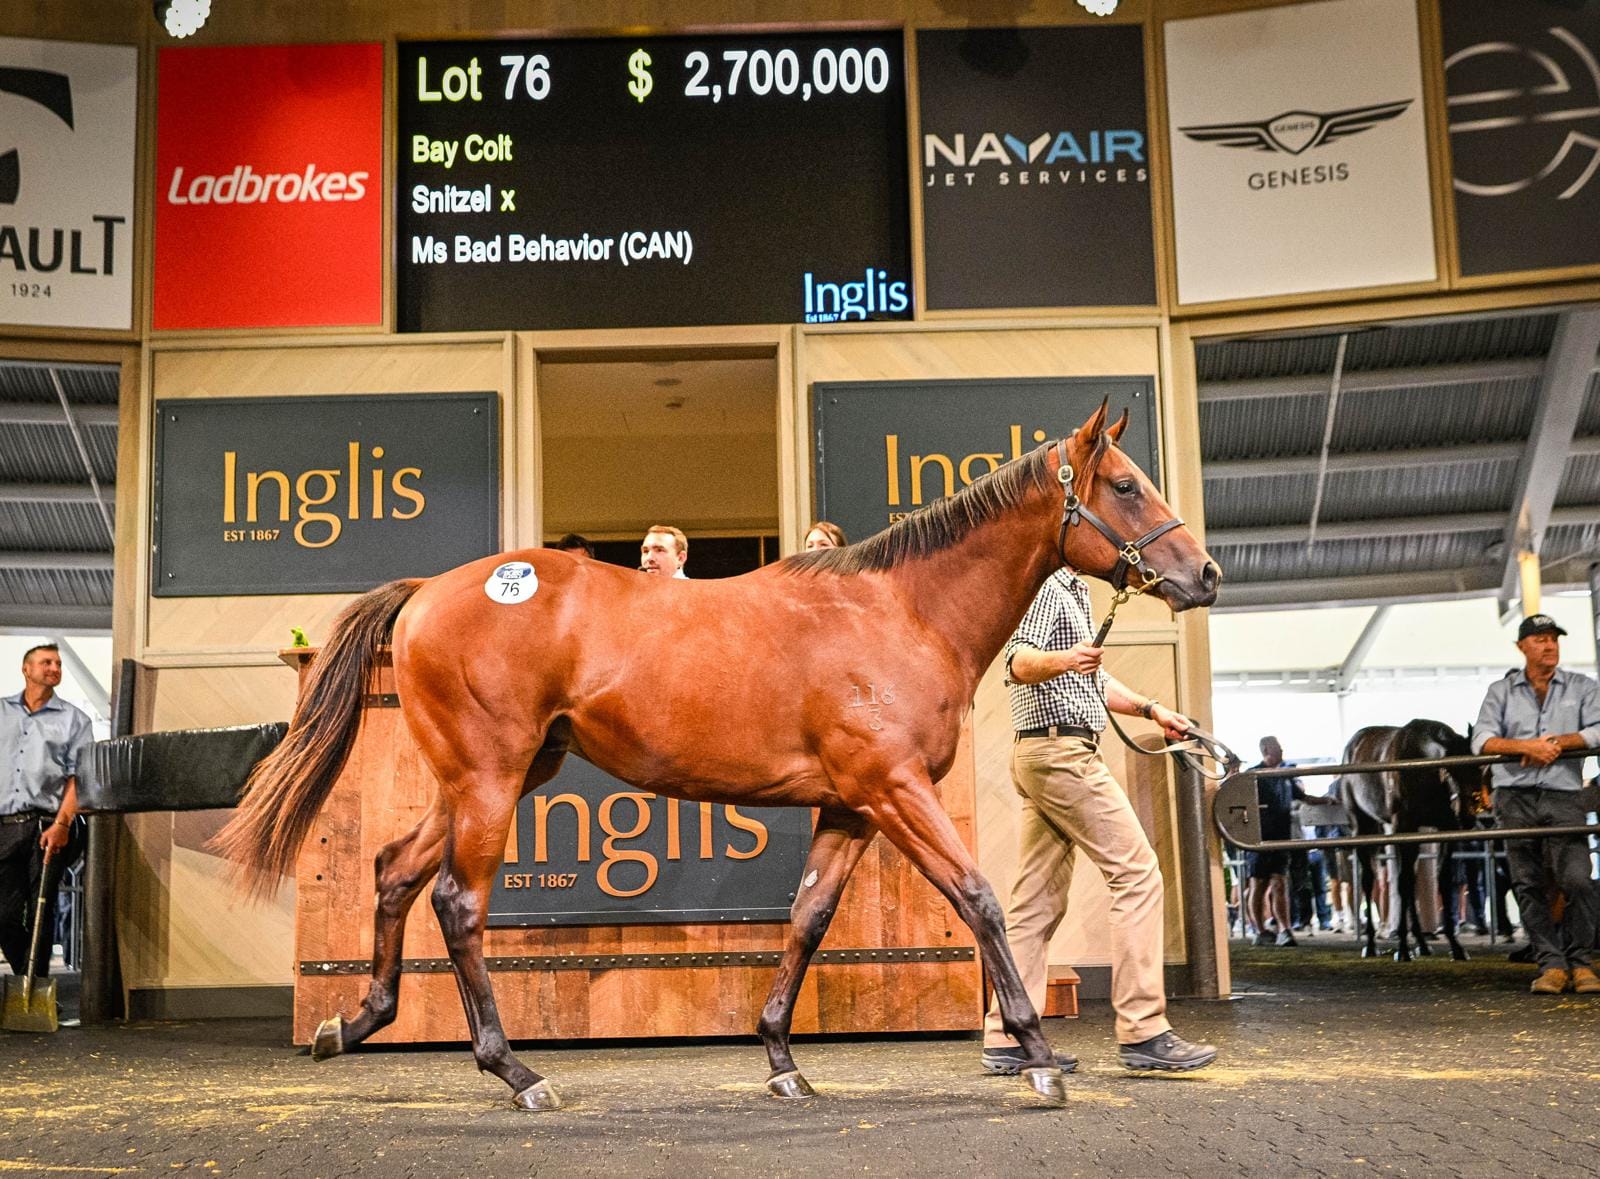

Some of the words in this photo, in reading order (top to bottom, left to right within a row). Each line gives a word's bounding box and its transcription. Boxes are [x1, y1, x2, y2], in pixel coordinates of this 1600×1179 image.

[417, 57, 482, 101] Lot
[500, 54, 552, 100] 76
[627, 49, 653, 103] $
[684, 47, 889, 103] 2,700,000
[412, 135, 459, 168] Bay
[465, 134, 512, 162] Colt
[925, 129, 1144, 167] NAVAIR
[168, 164, 368, 205] Ladbrokes
[926, 172, 975, 187] JET
[999, 168, 1147, 186] SERVICES
[1248, 162, 1349, 190] GENESIS
[412, 184, 491, 213] Snitzel
[500, 189, 515, 211] x
[412, 236, 447, 263] Ms
[455, 235, 500, 262] Bad
[508, 232, 613, 261] Behavior
[619, 230, 693, 266] (CAN)
[11, 283, 51, 298] 1924
[804, 268, 908, 321] Inglis
[223, 441, 425, 548] Inglis
[223, 530, 245, 542] EST
[249, 529, 280, 541] 1867
[501, 582, 520, 597] 76
[504, 873, 533, 888] EST
[537, 873, 578, 888] 1867
